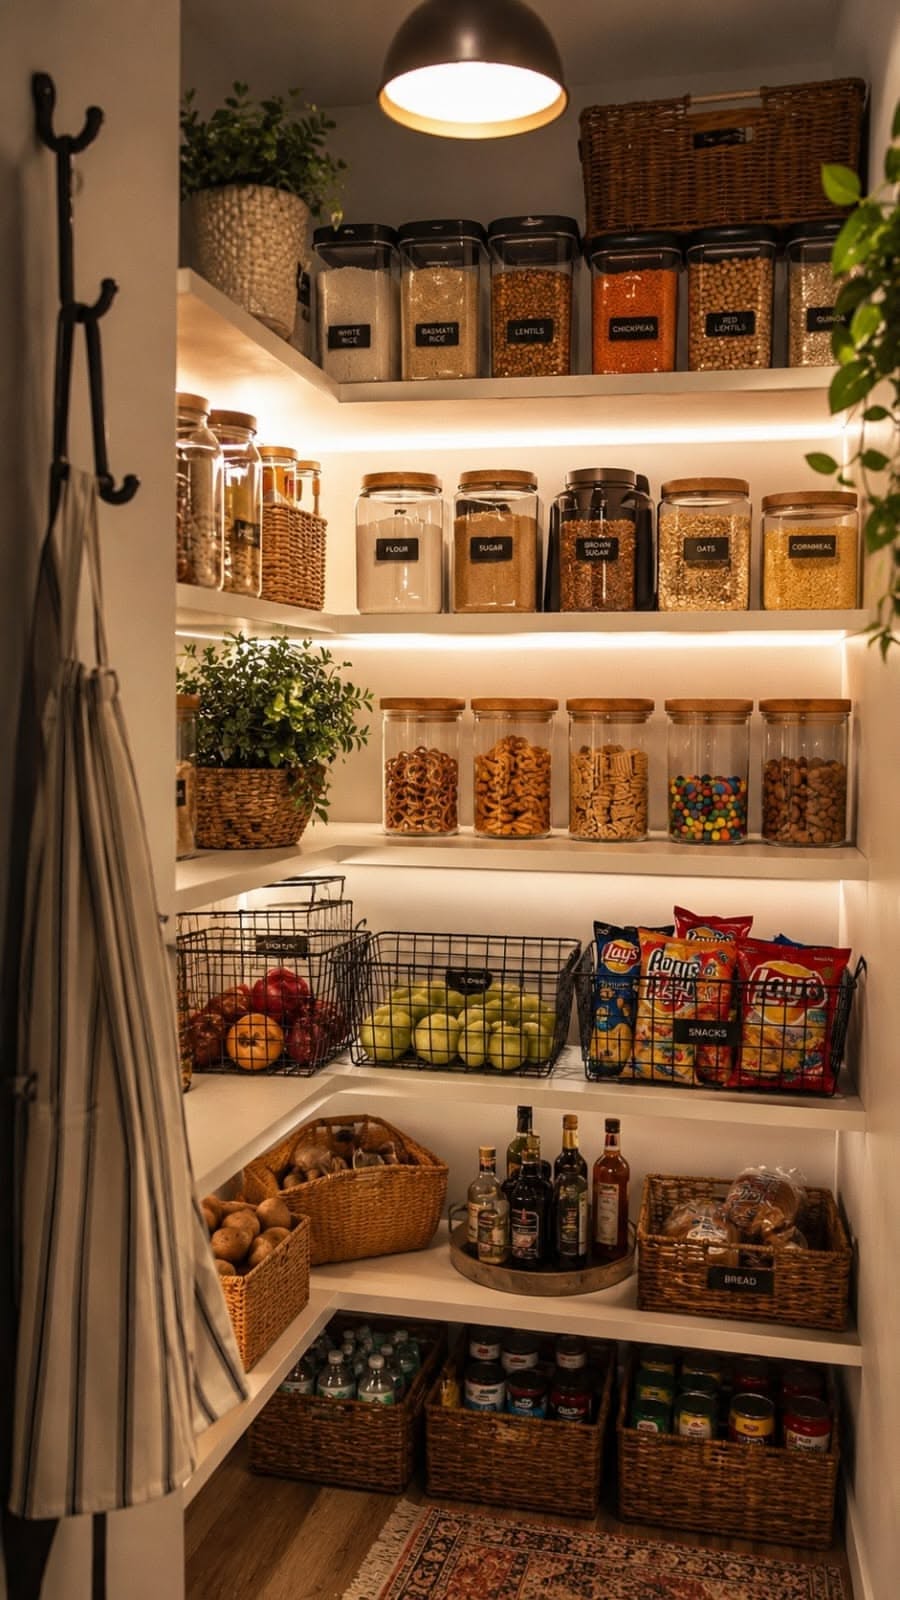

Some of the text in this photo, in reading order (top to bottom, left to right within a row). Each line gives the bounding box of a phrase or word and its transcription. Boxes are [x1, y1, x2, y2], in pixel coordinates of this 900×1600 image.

[722, 316, 738, 324] RED
[338, 328, 361, 336] WHITE
[421, 327, 454, 335] BASMATI
[515, 328, 544, 336] LENTILS
[612, 324, 654, 333] CHICKPEAS
[714, 324, 746, 333] LENTILS
[341, 336, 358, 344] RICE
[428, 335, 445, 343] RICE
[385, 545, 409, 553] FLOUR
[479, 544, 503, 552] SUGAR
[584, 541, 611, 549] BROWN
[696, 545, 716, 553] OATS
[791, 543, 832, 551] CORNMEAL
[585, 548, 609, 556] SUGAR
[688, 1028, 728, 1038] SNACKS
[724, 1274, 757, 1286] BREAD
